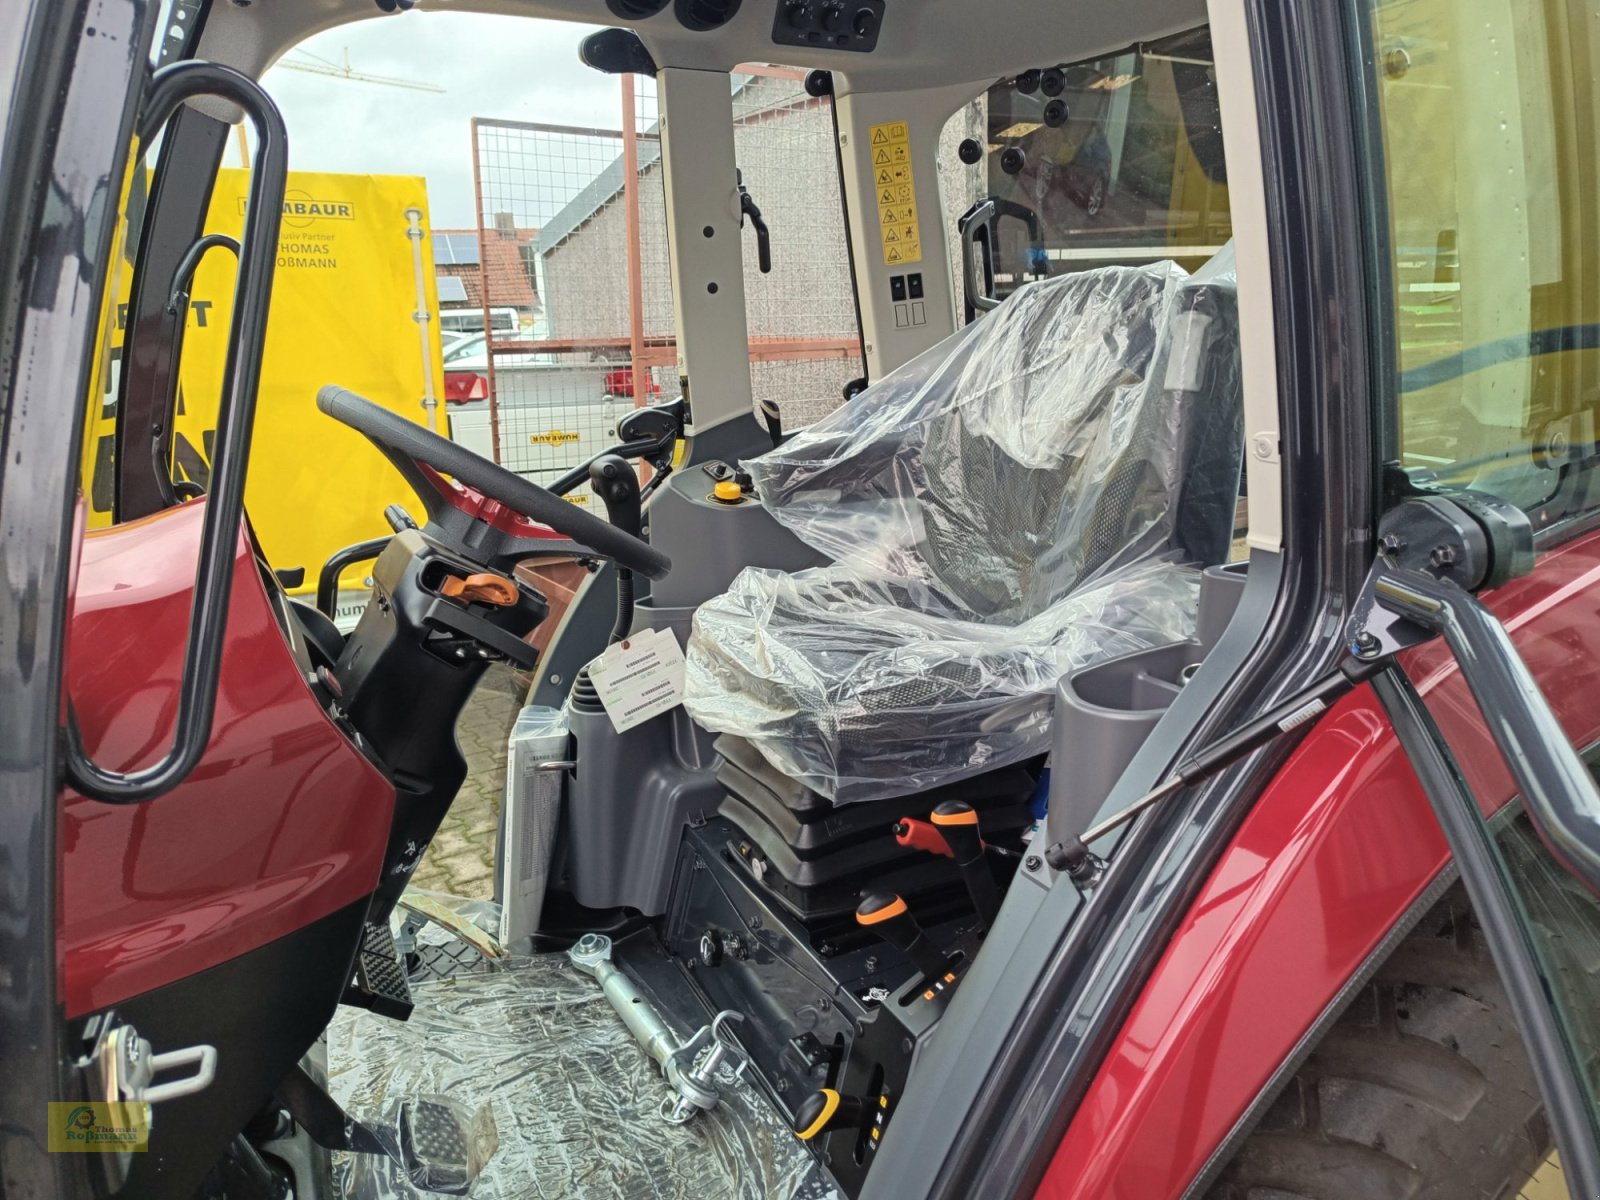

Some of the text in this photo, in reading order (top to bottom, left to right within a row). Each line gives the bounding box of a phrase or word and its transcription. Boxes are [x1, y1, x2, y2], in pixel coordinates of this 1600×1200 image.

[302, 232, 336, 241] Partner
[279, 243, 329, 254] HOMAS
[276, 256, 337, 269] OßMANN
